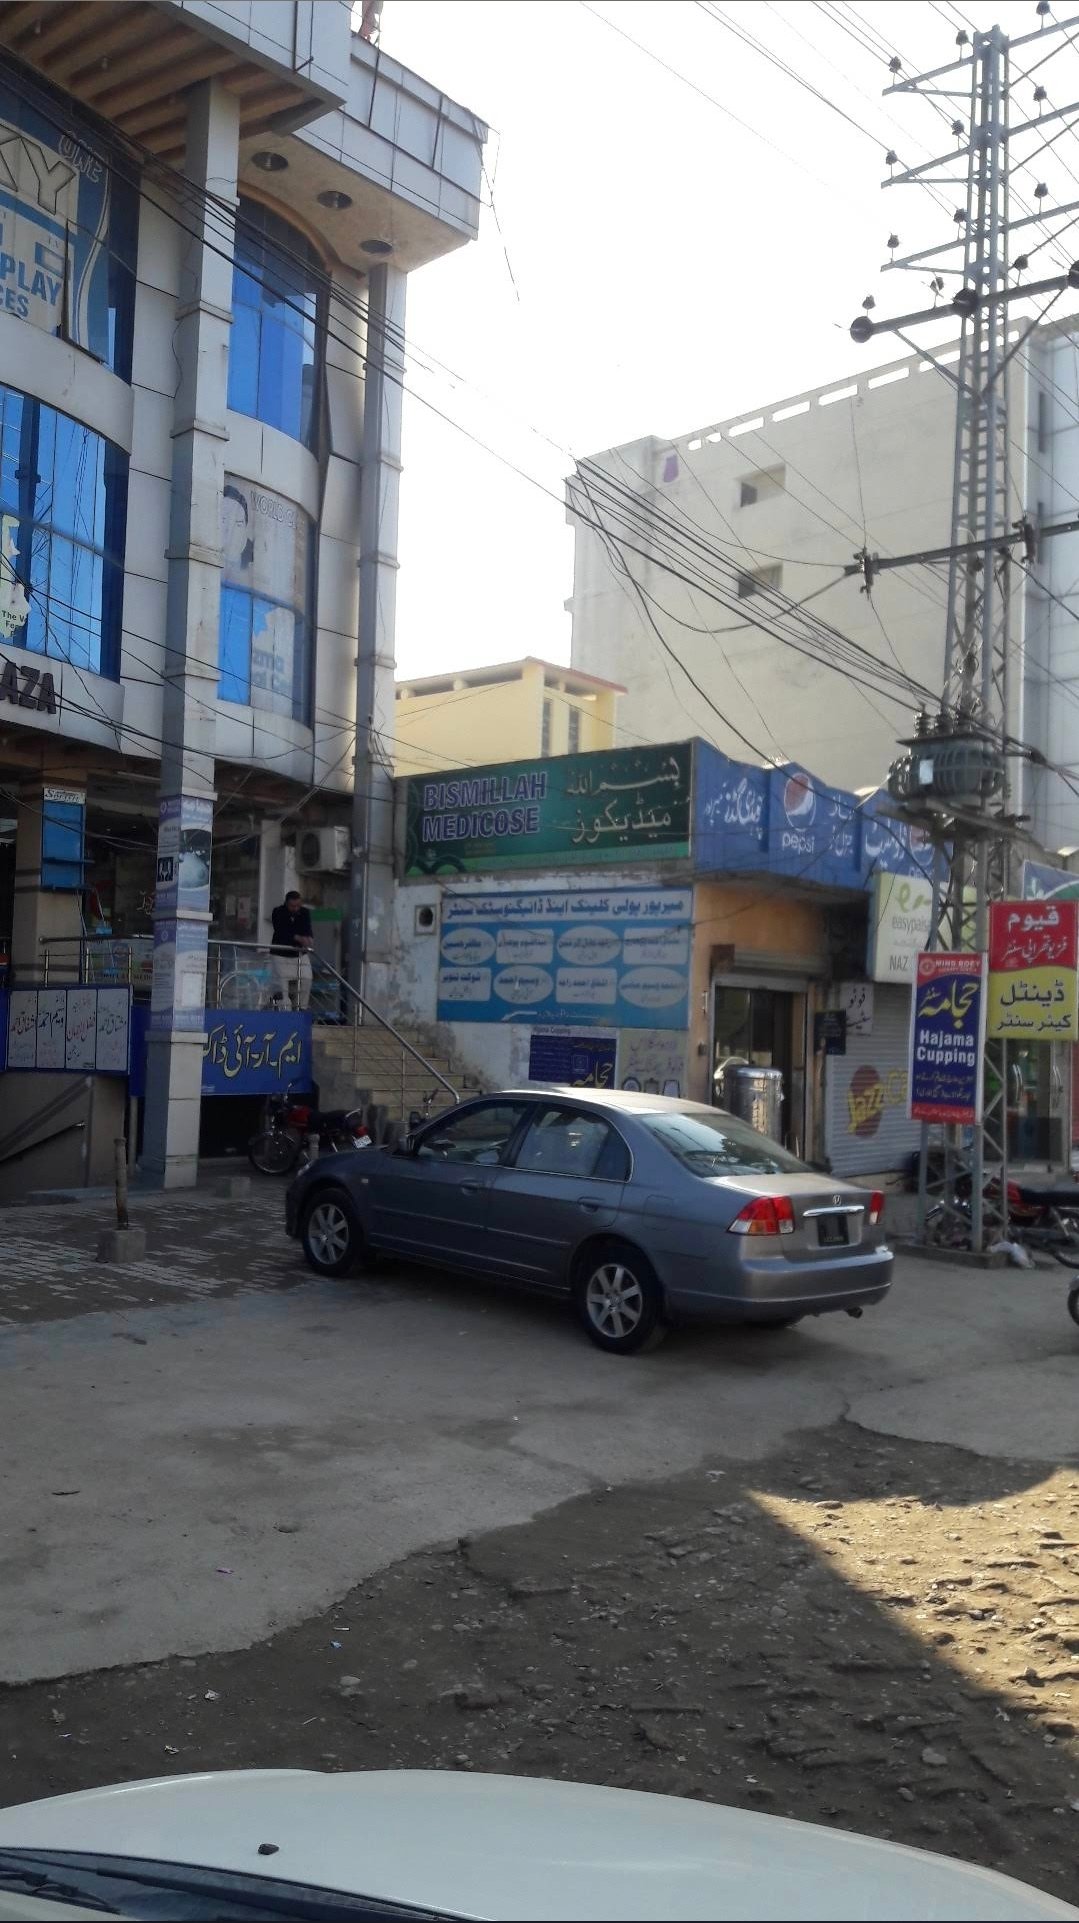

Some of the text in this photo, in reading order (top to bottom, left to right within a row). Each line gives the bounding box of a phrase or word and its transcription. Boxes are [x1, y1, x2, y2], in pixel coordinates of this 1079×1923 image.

[2, 609, 17, 620] The
[424, 771, 549, 812] BISMILLAH
[422, 806, 541, 843] MEDICOSE
[782, 832, 815, 853] pepsi
[1007, 904, 1060, 933] قیوم
[889, 955, 909, 972] NAZ
[1000, 979, 1066, 1007] ڈینٹل
[919, 1029, 975, 1048] Hajama
[916, 1046, 976, 1067] Cupping
